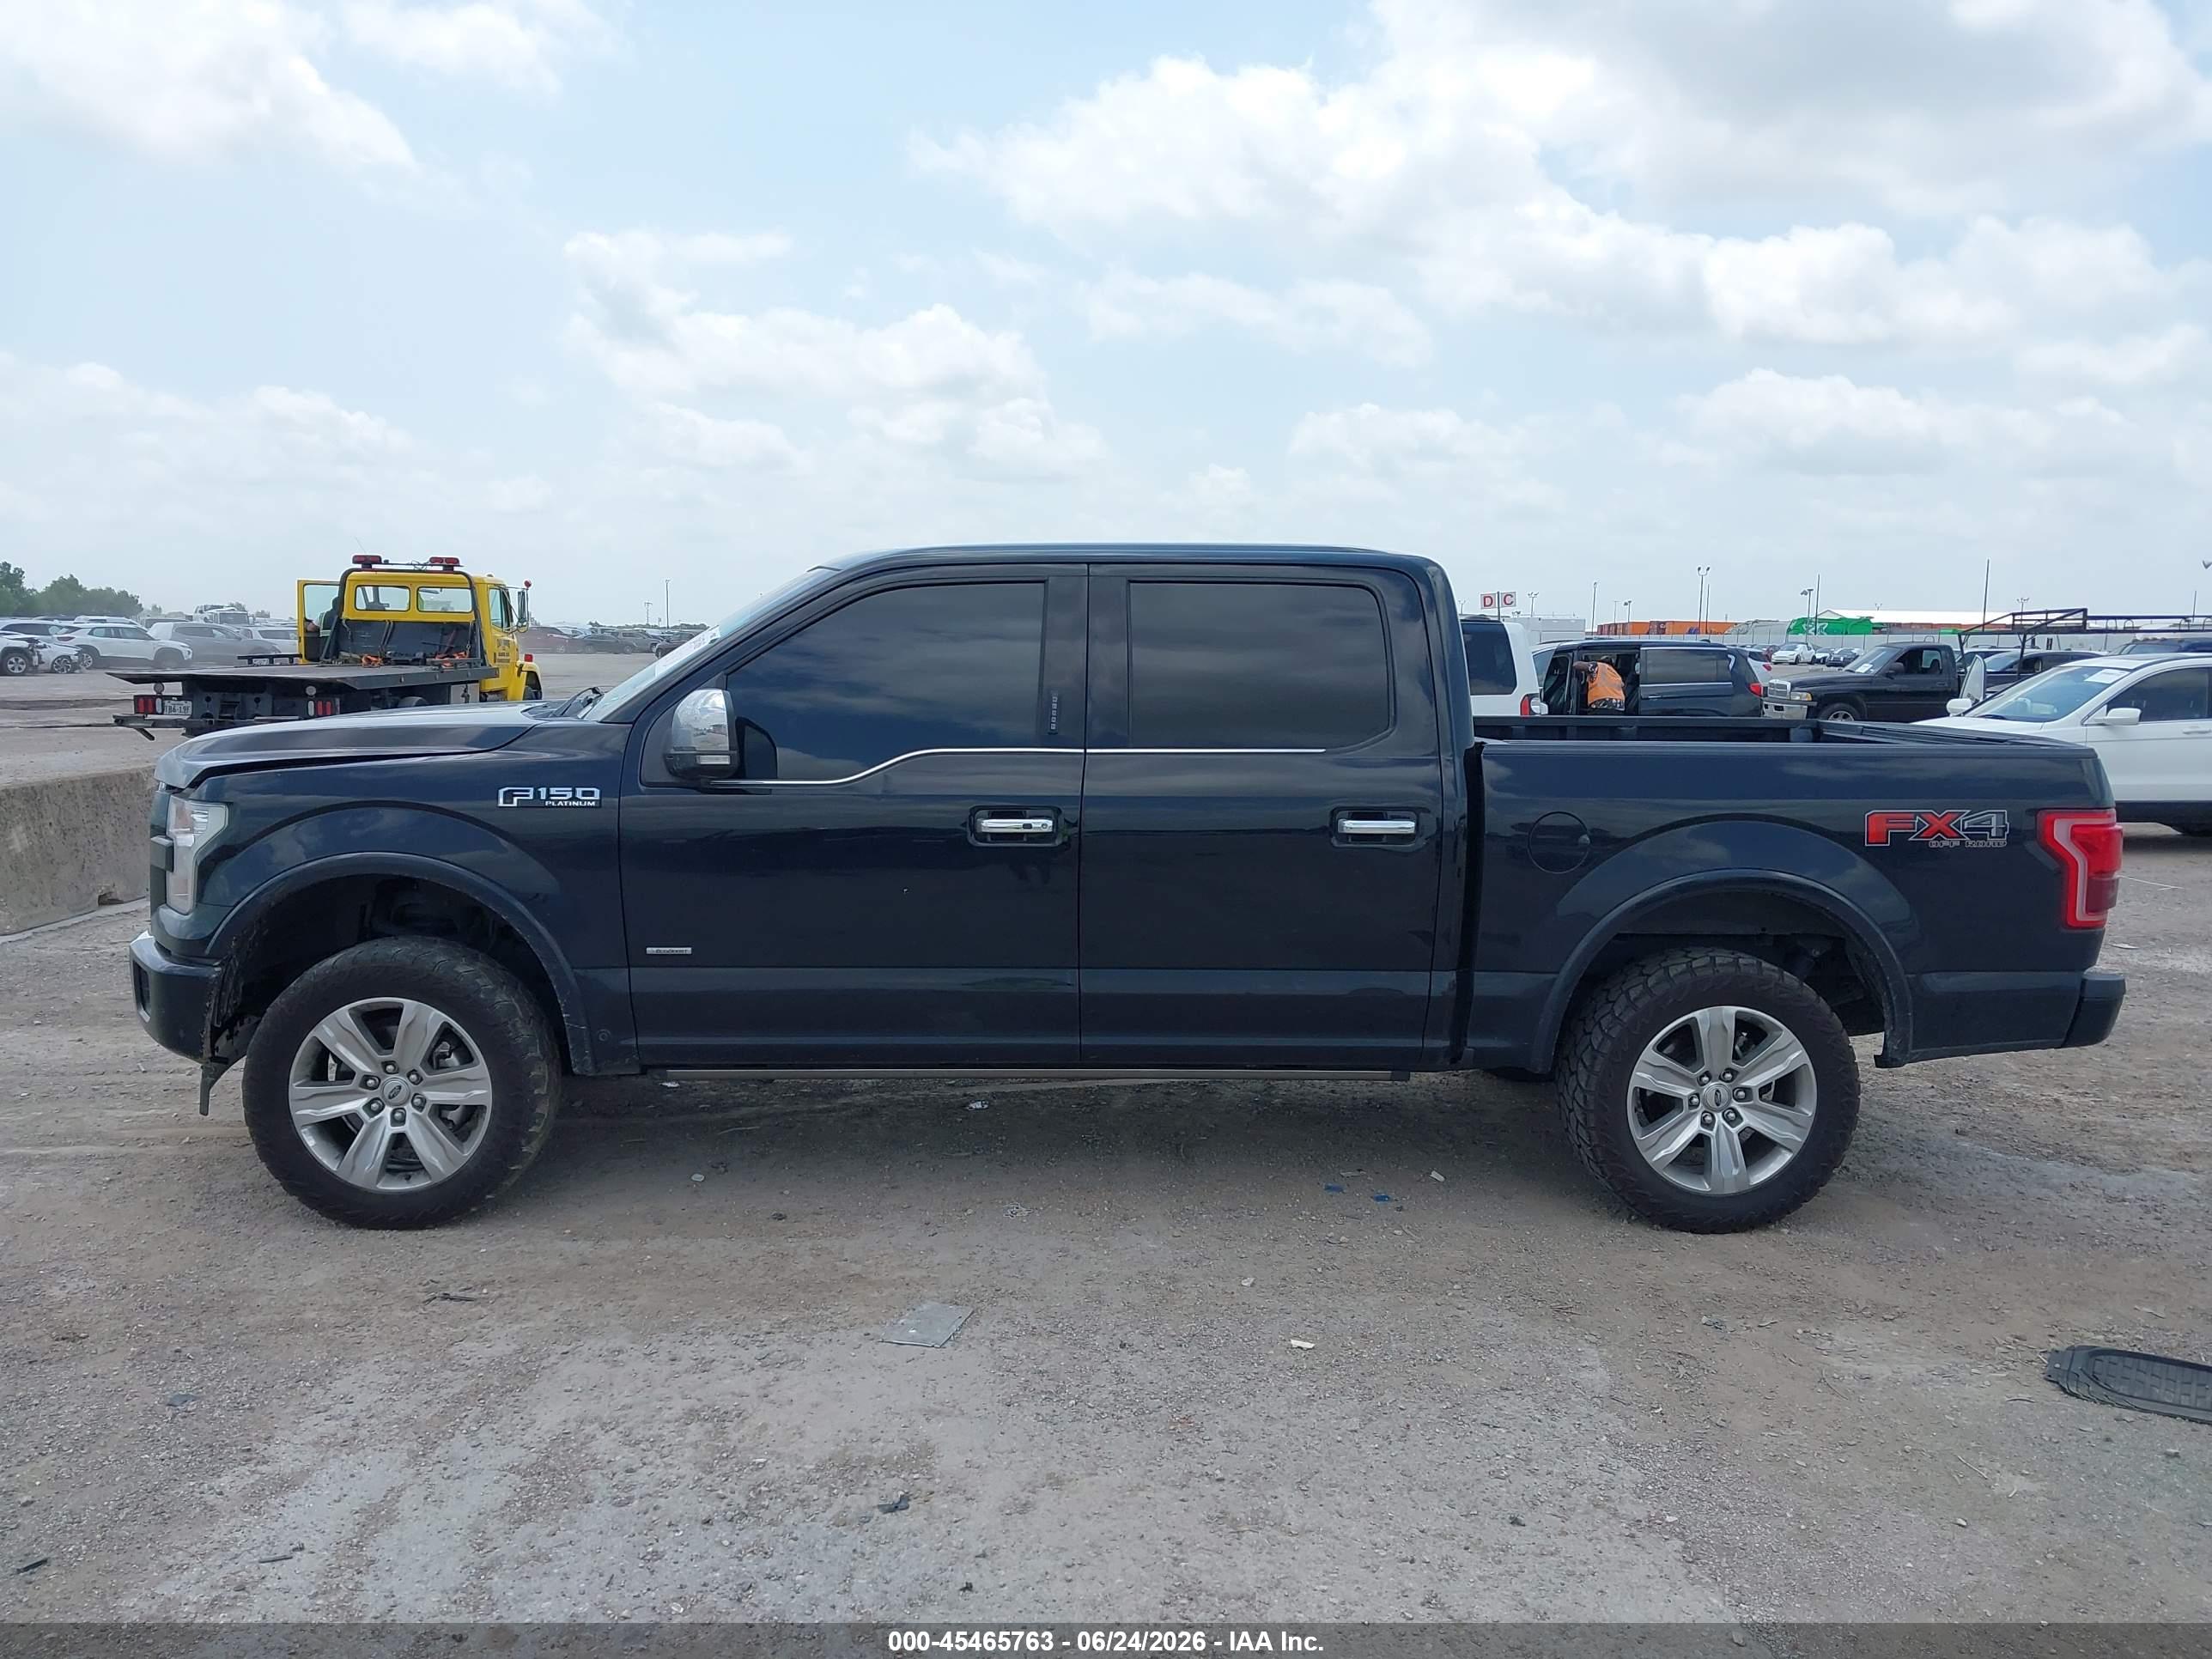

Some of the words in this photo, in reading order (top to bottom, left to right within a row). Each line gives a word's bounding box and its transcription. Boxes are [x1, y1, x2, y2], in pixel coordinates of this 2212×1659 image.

[1483, 595, 1493, 608] D
[1503, 593, 1514, 606] C
[1865, 810, 2009, 847] FX4
[1929, 840, 1960, 848] OFF
[1965, 840, 2008, 848] ROAD
